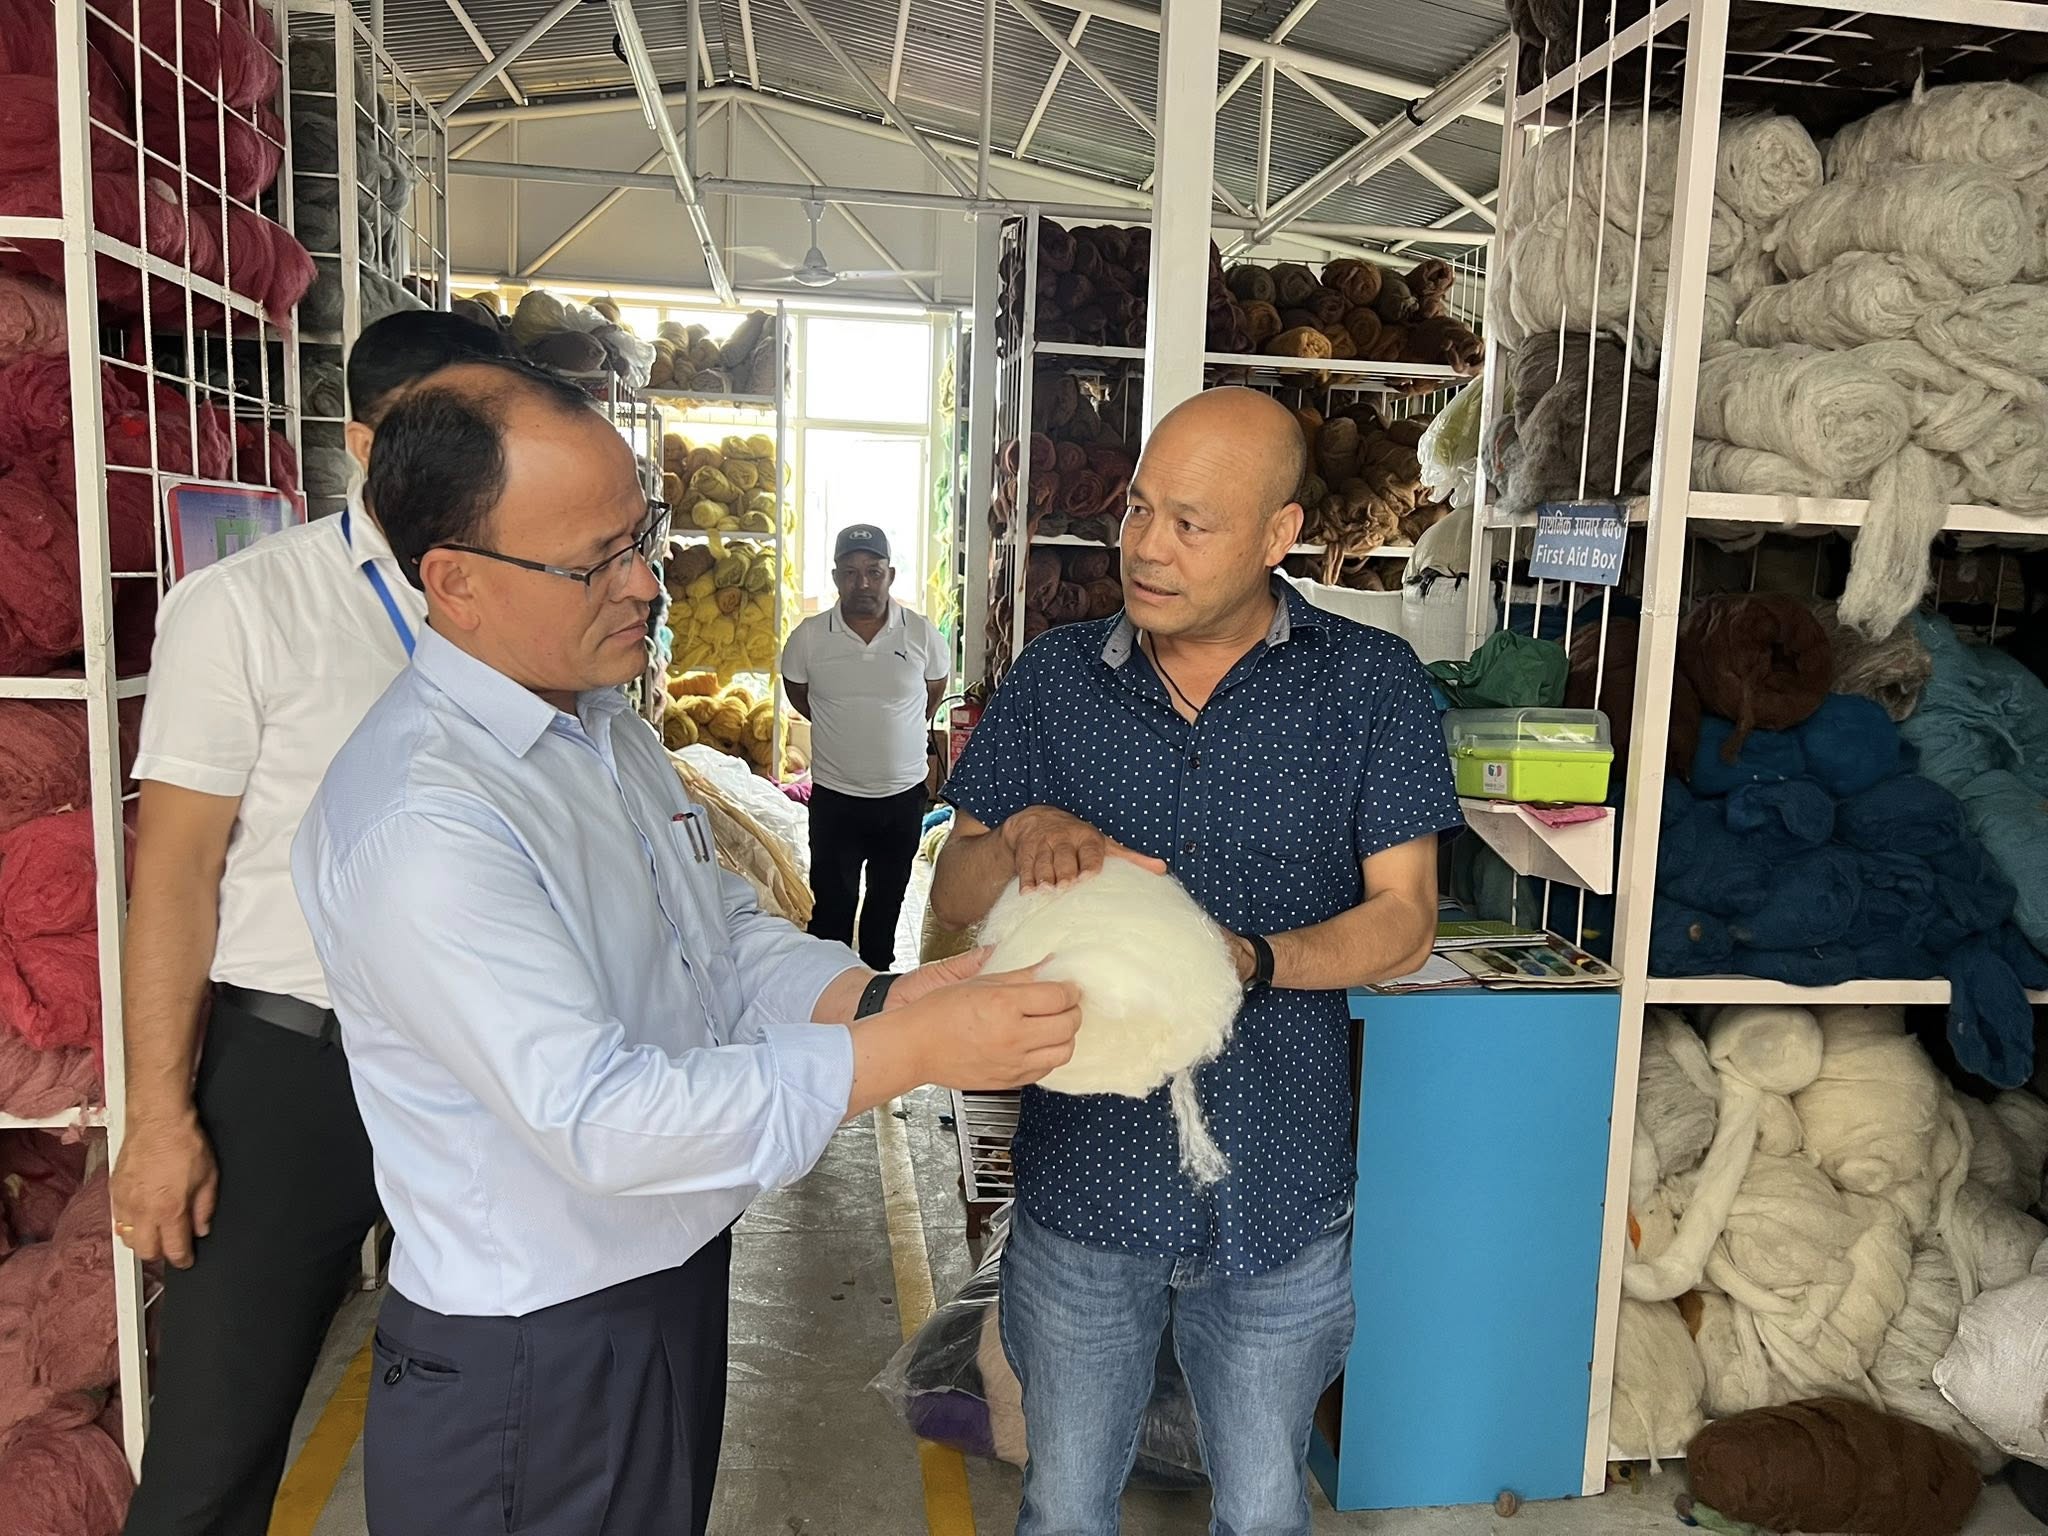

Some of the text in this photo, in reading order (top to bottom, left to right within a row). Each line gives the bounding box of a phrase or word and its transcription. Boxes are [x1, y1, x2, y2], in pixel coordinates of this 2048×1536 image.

[1573, 517, 1602, 538] उपचार
[1535, 543, 1617, 570] First Aid Box
